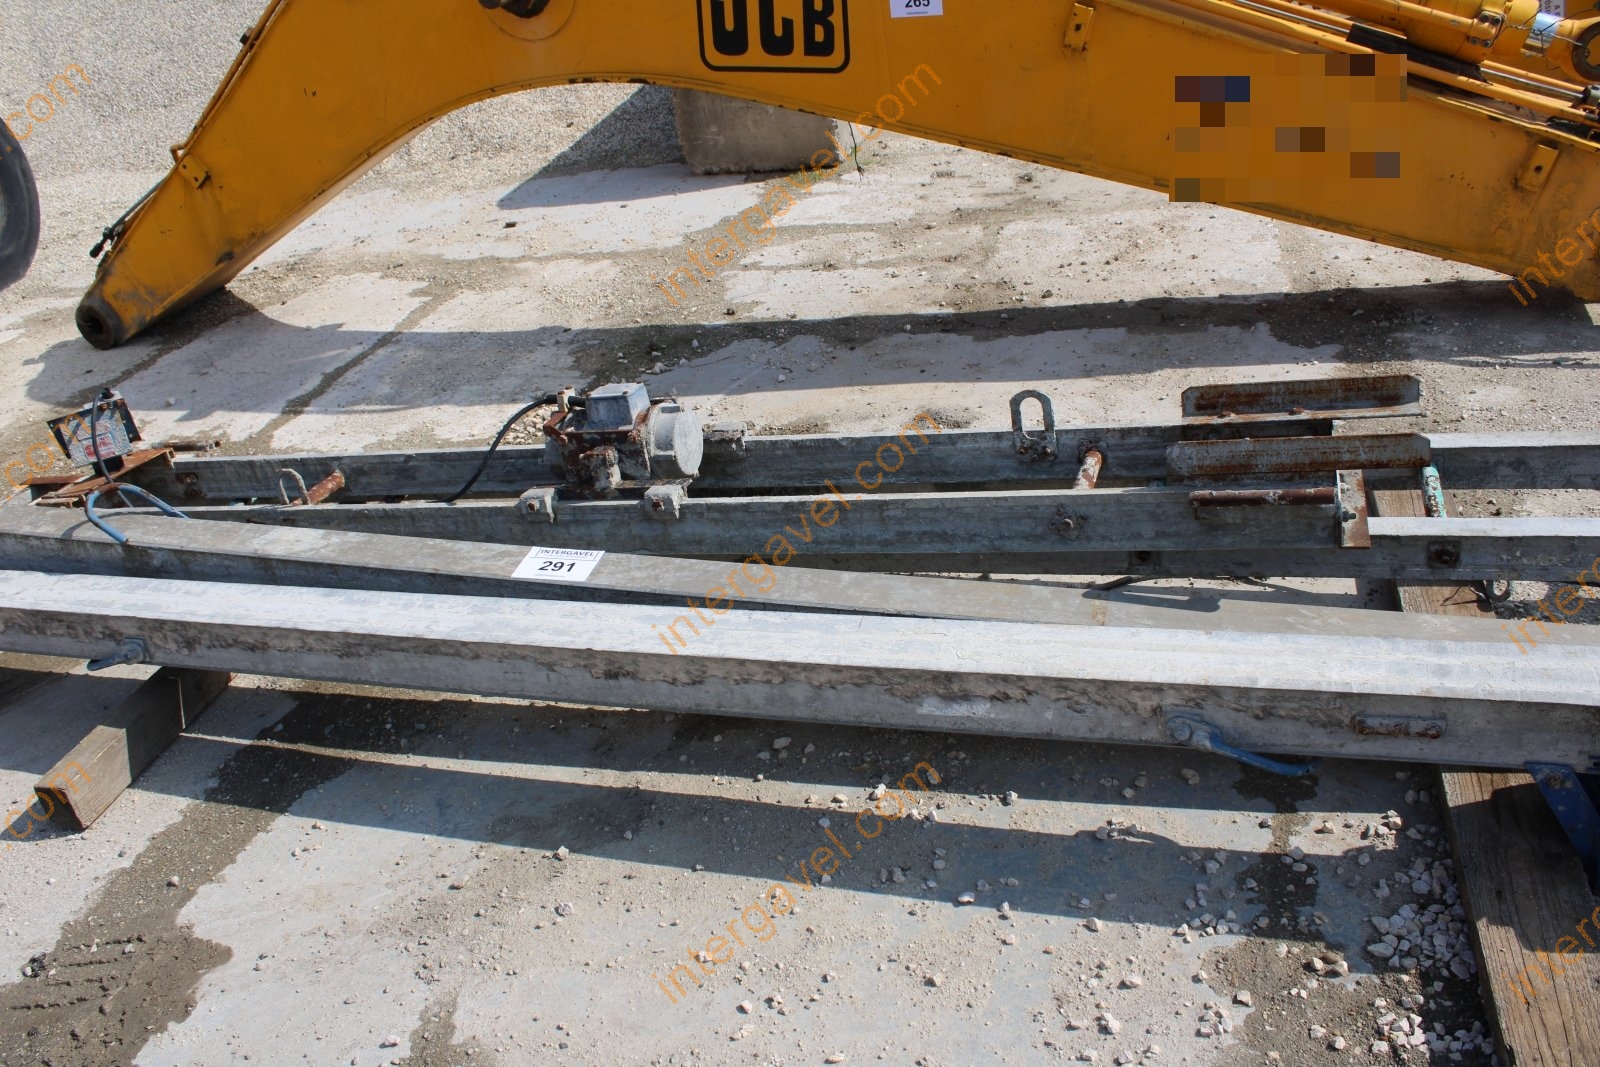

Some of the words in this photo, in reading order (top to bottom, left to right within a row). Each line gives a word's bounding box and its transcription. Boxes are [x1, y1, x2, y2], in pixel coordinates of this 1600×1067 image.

[905, 0, 930, 8] 265
[711, 0, 835, 57] JCB
[540, 548, 595, 557] INTERGAVEL
[538, 560, 576, 572] 291
